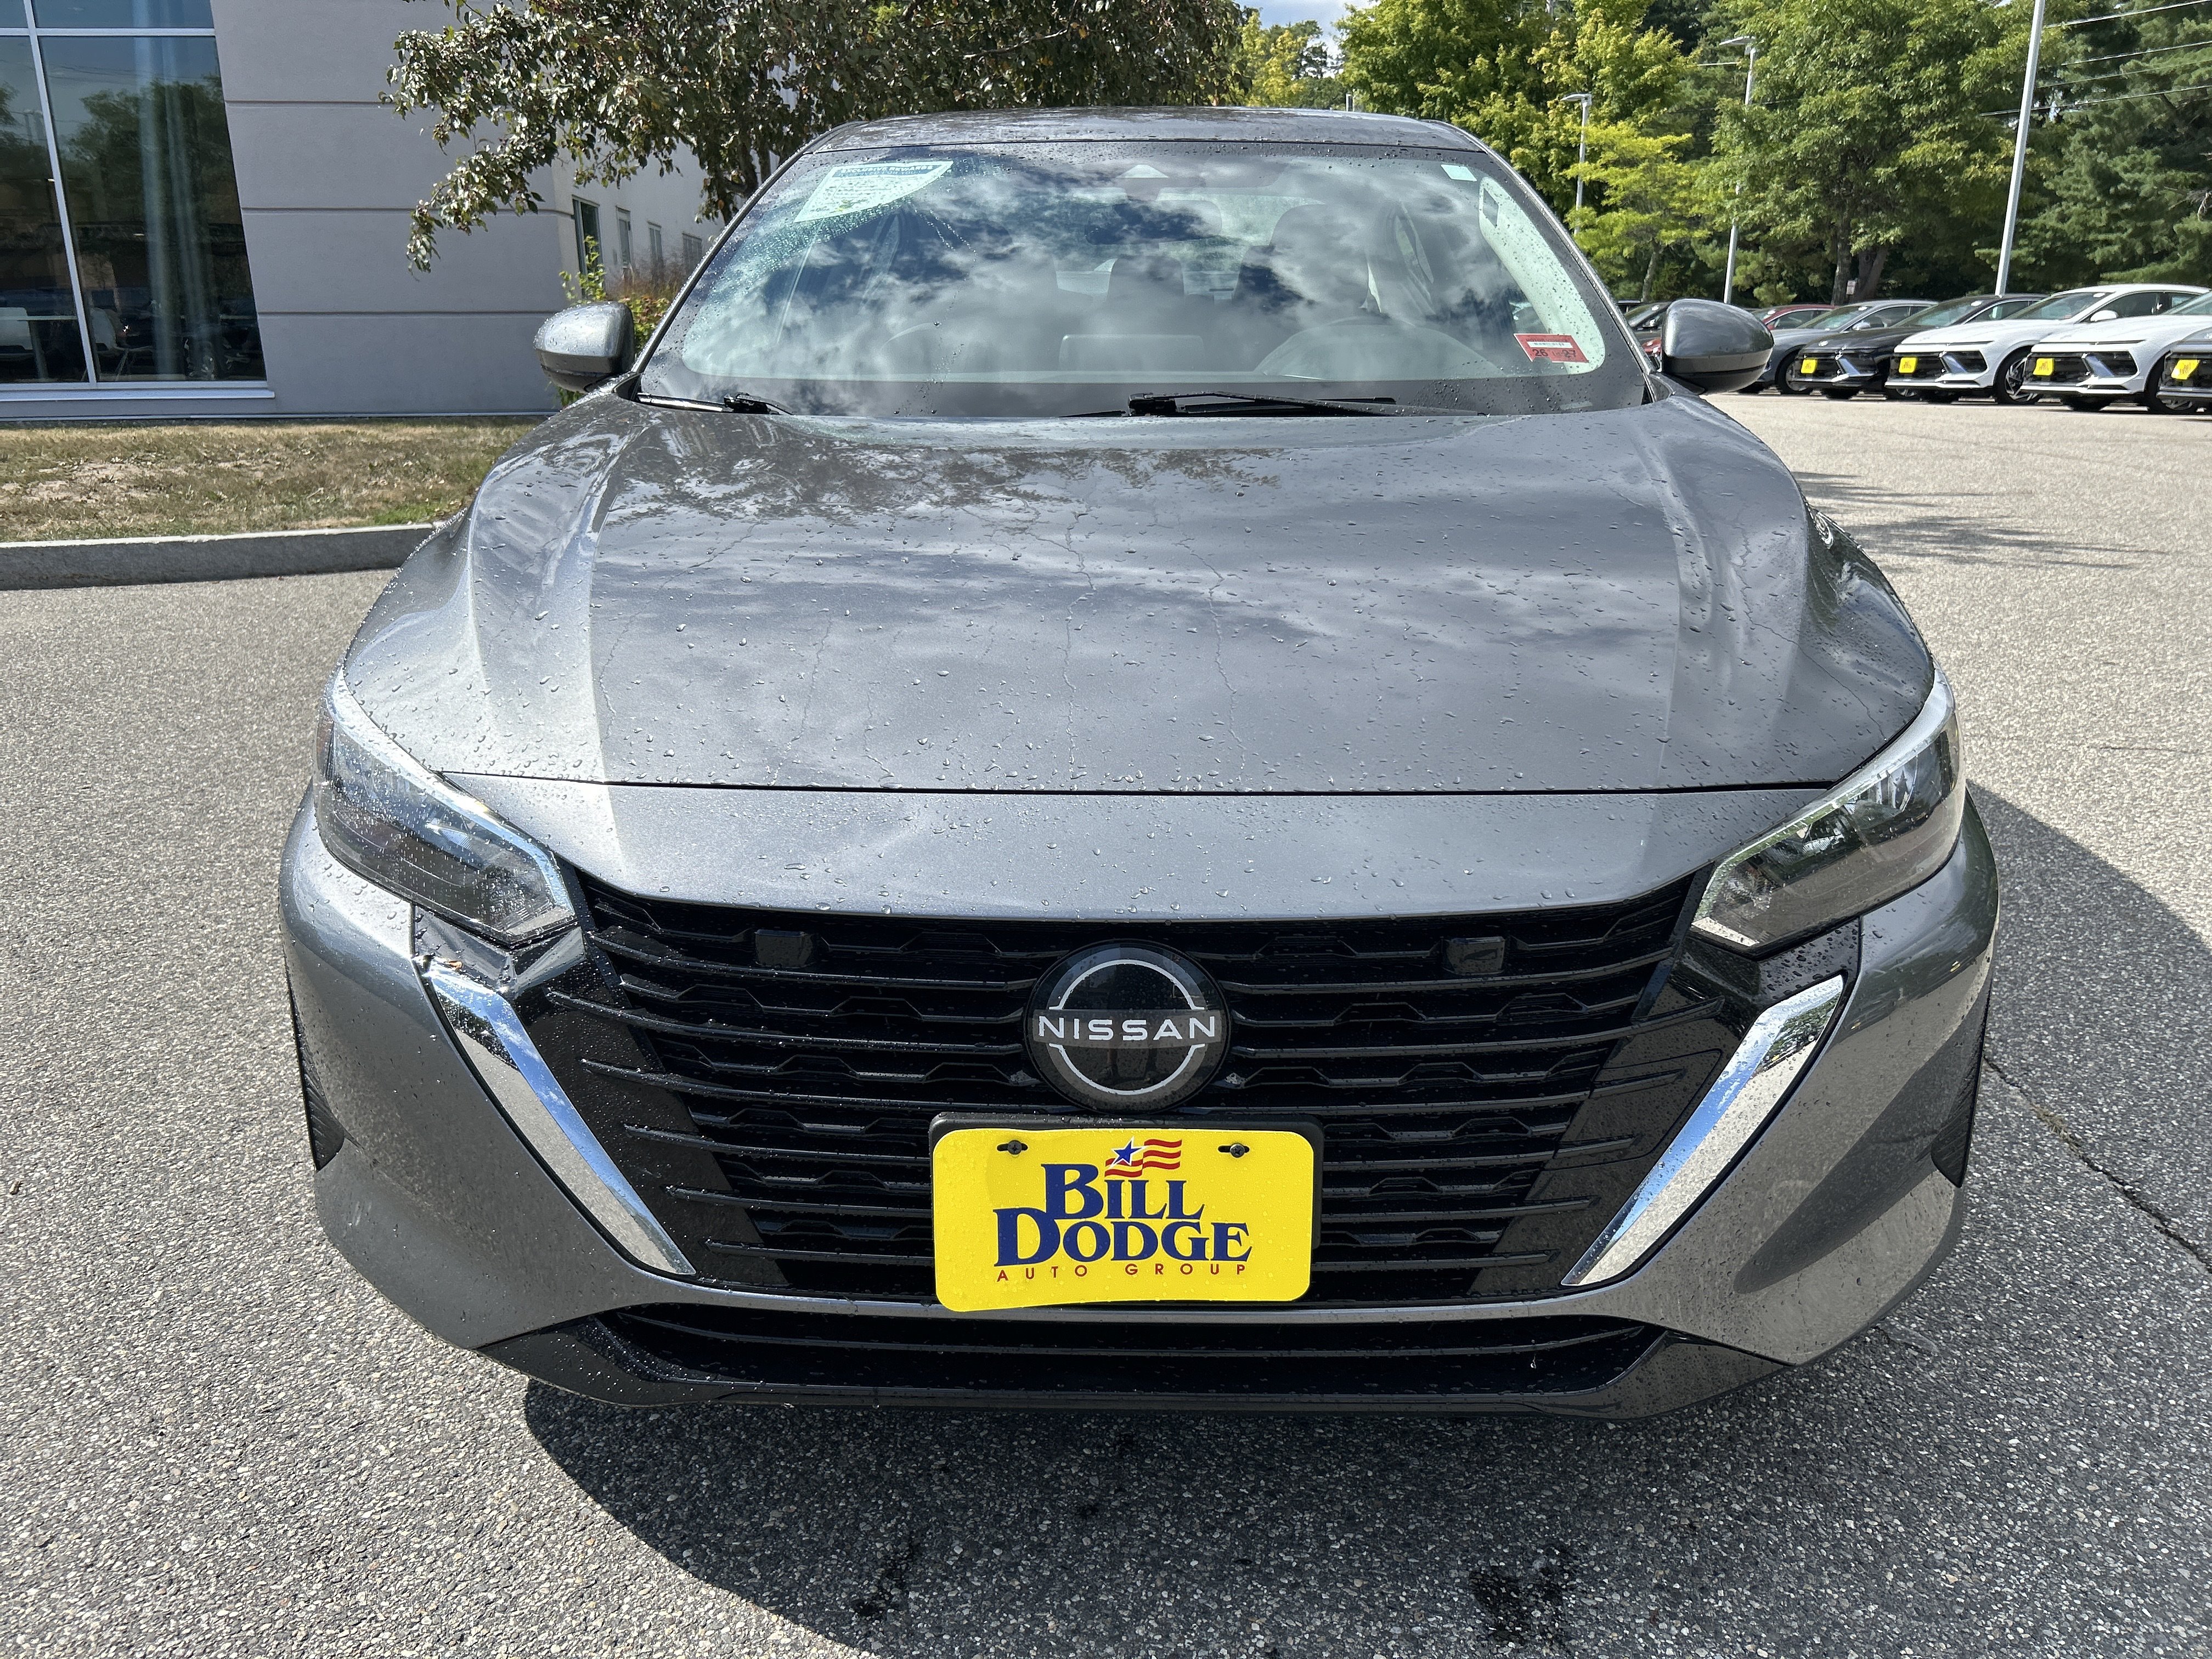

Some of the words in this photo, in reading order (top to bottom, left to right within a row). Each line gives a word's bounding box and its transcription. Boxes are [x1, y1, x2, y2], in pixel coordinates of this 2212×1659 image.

[1039, 1015, 1215, 1041] NISSAN
[1041, 1163, 1205, 1220] BILL
[993, 1207, 1252, 1267] DODGE
[996, 1265, 1088, 1282] AUTO
[1124, 1262, 1246, 1276] GROUP
